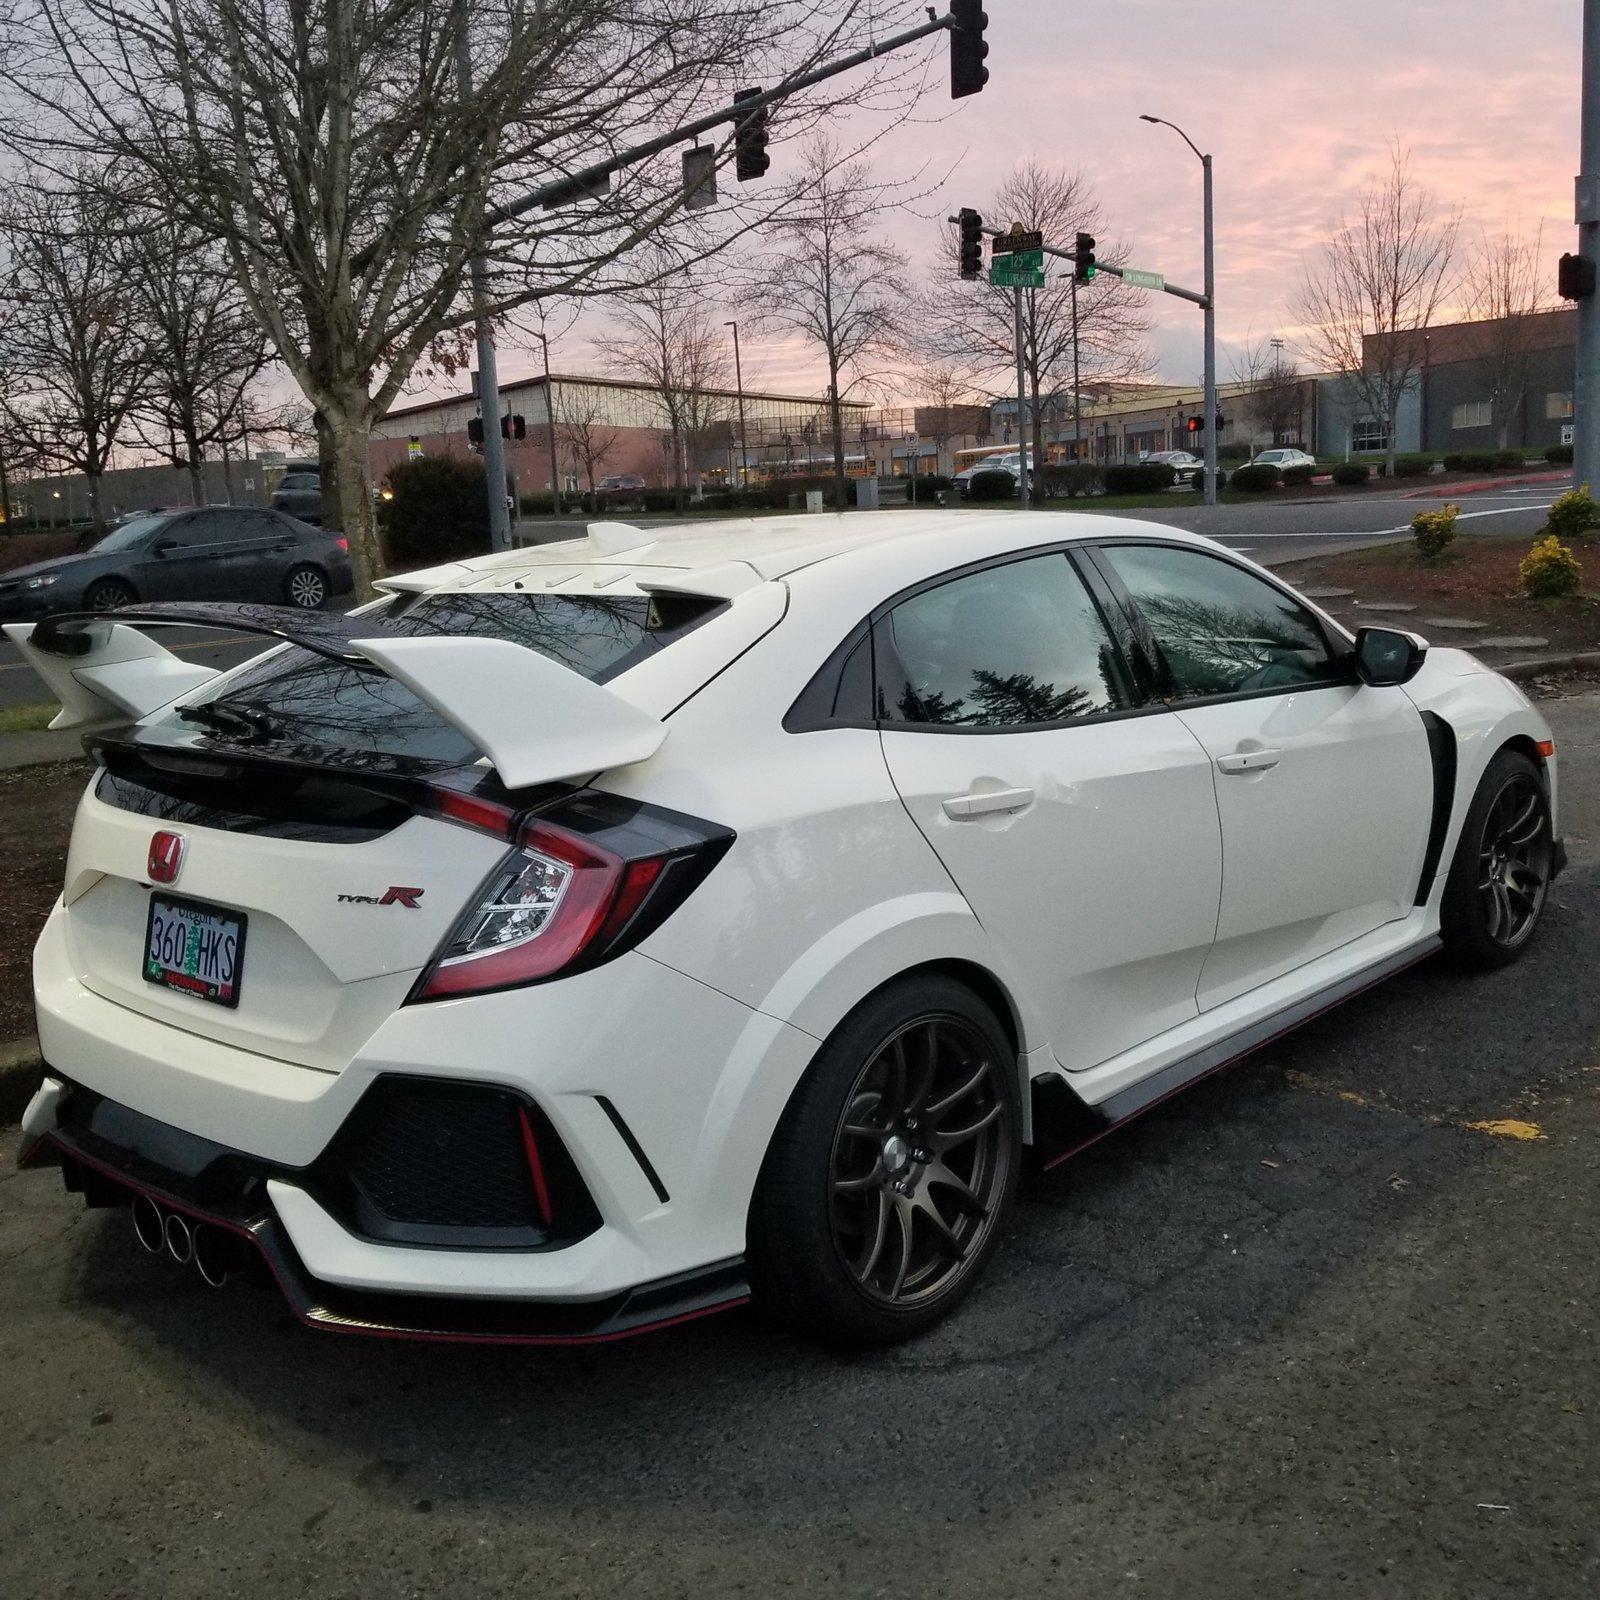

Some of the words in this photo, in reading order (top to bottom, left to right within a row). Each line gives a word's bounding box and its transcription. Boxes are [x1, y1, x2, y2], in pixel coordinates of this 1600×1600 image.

[378, 886, 425, 909] R
[151, 916, 187, 968] 360
[196, 927, 236, 982] HKS
